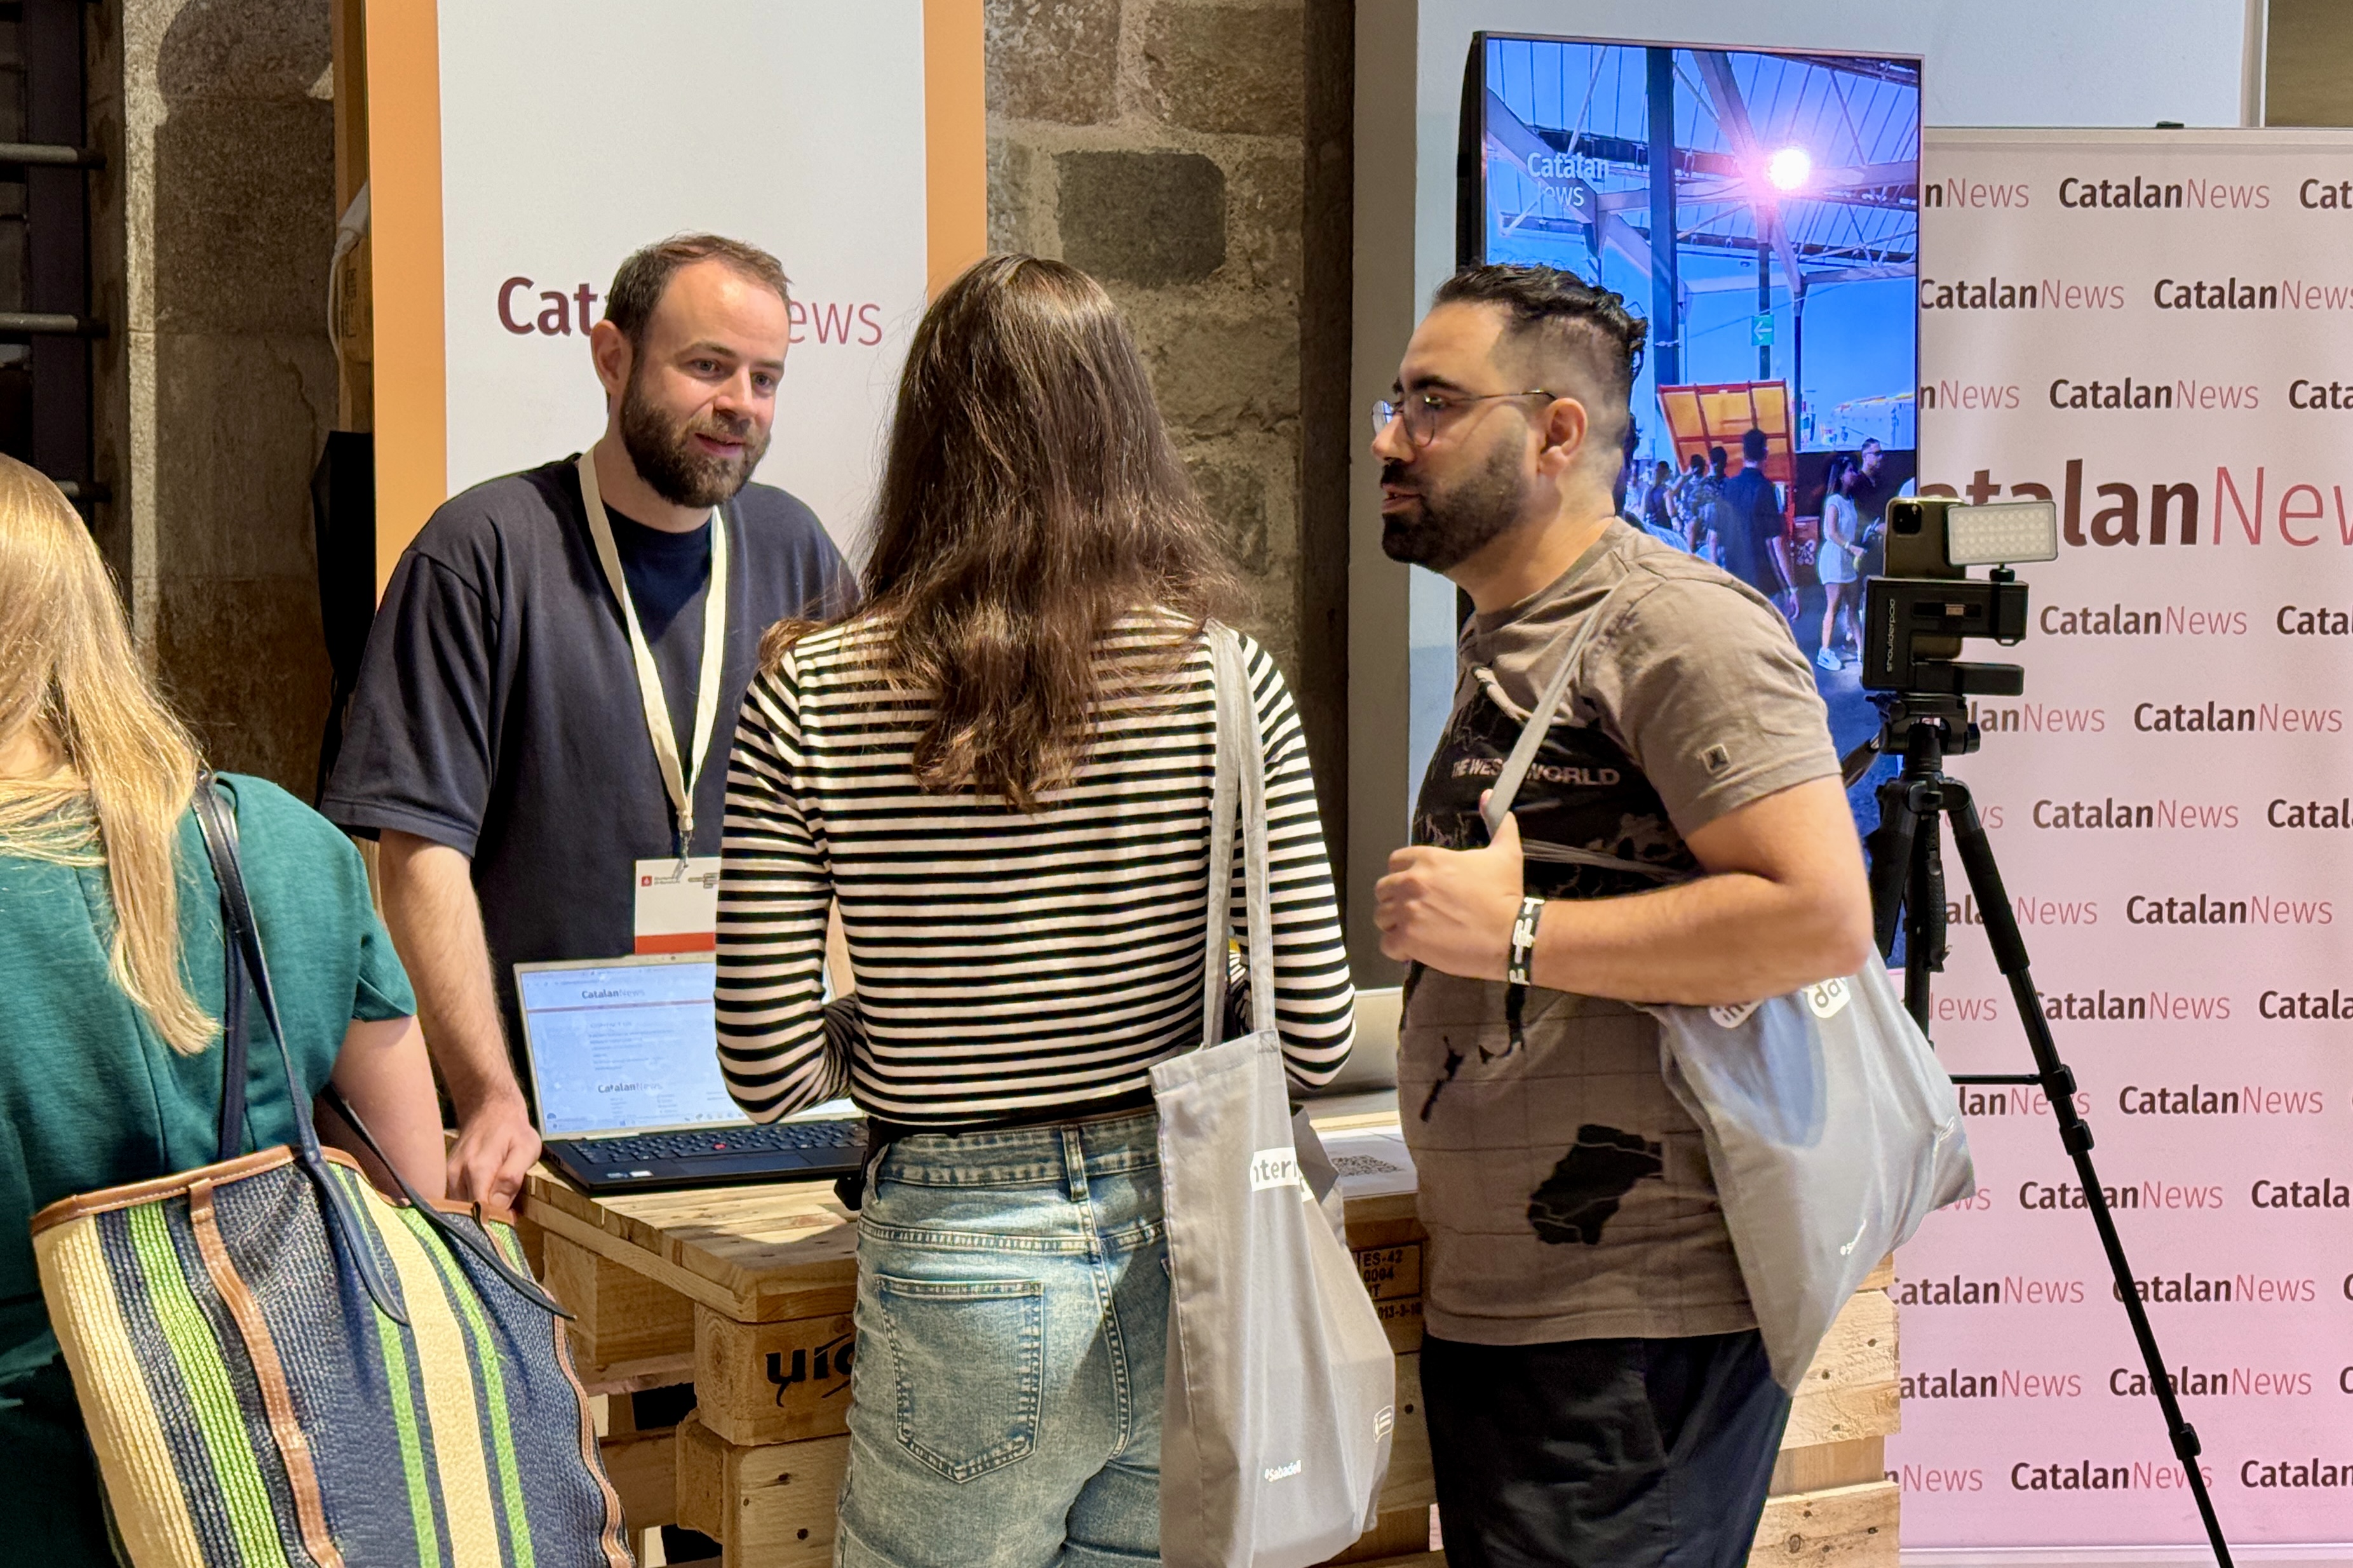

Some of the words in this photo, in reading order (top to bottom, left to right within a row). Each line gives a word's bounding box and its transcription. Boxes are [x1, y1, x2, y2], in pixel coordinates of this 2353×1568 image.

[2059, 175, 2270, 209] CatalanNews
[1920, 276, 2124, 310] CatalanNews
[2154, 277, 2353, 310] CatalanNew
[2049, 377, 2259, 410] CatalanNews
[2040, 603, 2248, 636] CatalanNews
[2134, 700, 2343, 732] CatalanNews
[2033, 798, 2239, 829] CatalanNews
[2126, 893, 2333, 925] CatalanNews
[582, 988, 645, 1000] CatalanNews
[2036, 989, 2230, 1021] atalanNews
[598, 1082, 664, 1094] CatalanNews
[2119, 1084, 2323, 1115] CatalanNews
[2019, 1179, 2223, 1210] CataanNews
